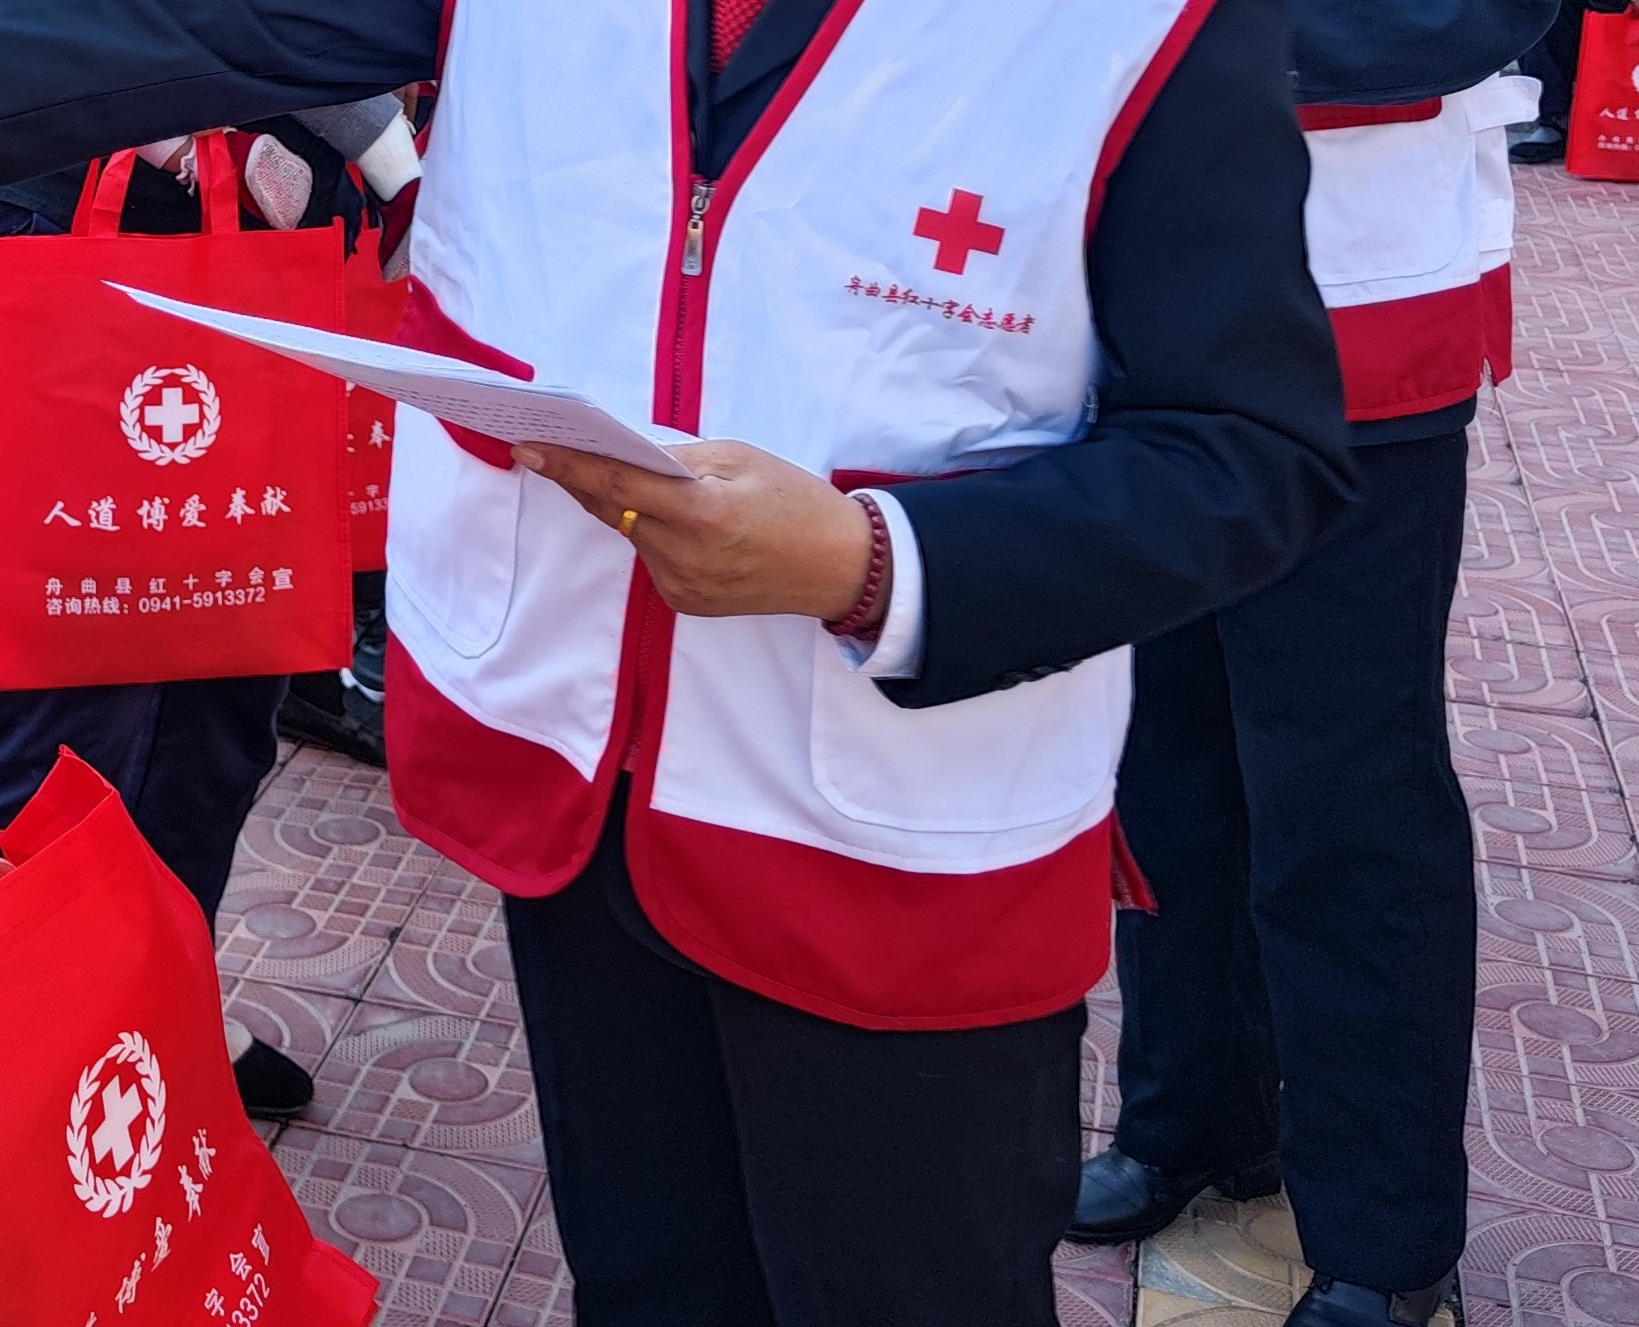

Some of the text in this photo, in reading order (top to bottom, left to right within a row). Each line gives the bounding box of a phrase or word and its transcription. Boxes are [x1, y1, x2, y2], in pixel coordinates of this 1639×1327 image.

[44, 485, 292, 532] 人道 博爱 奉献
